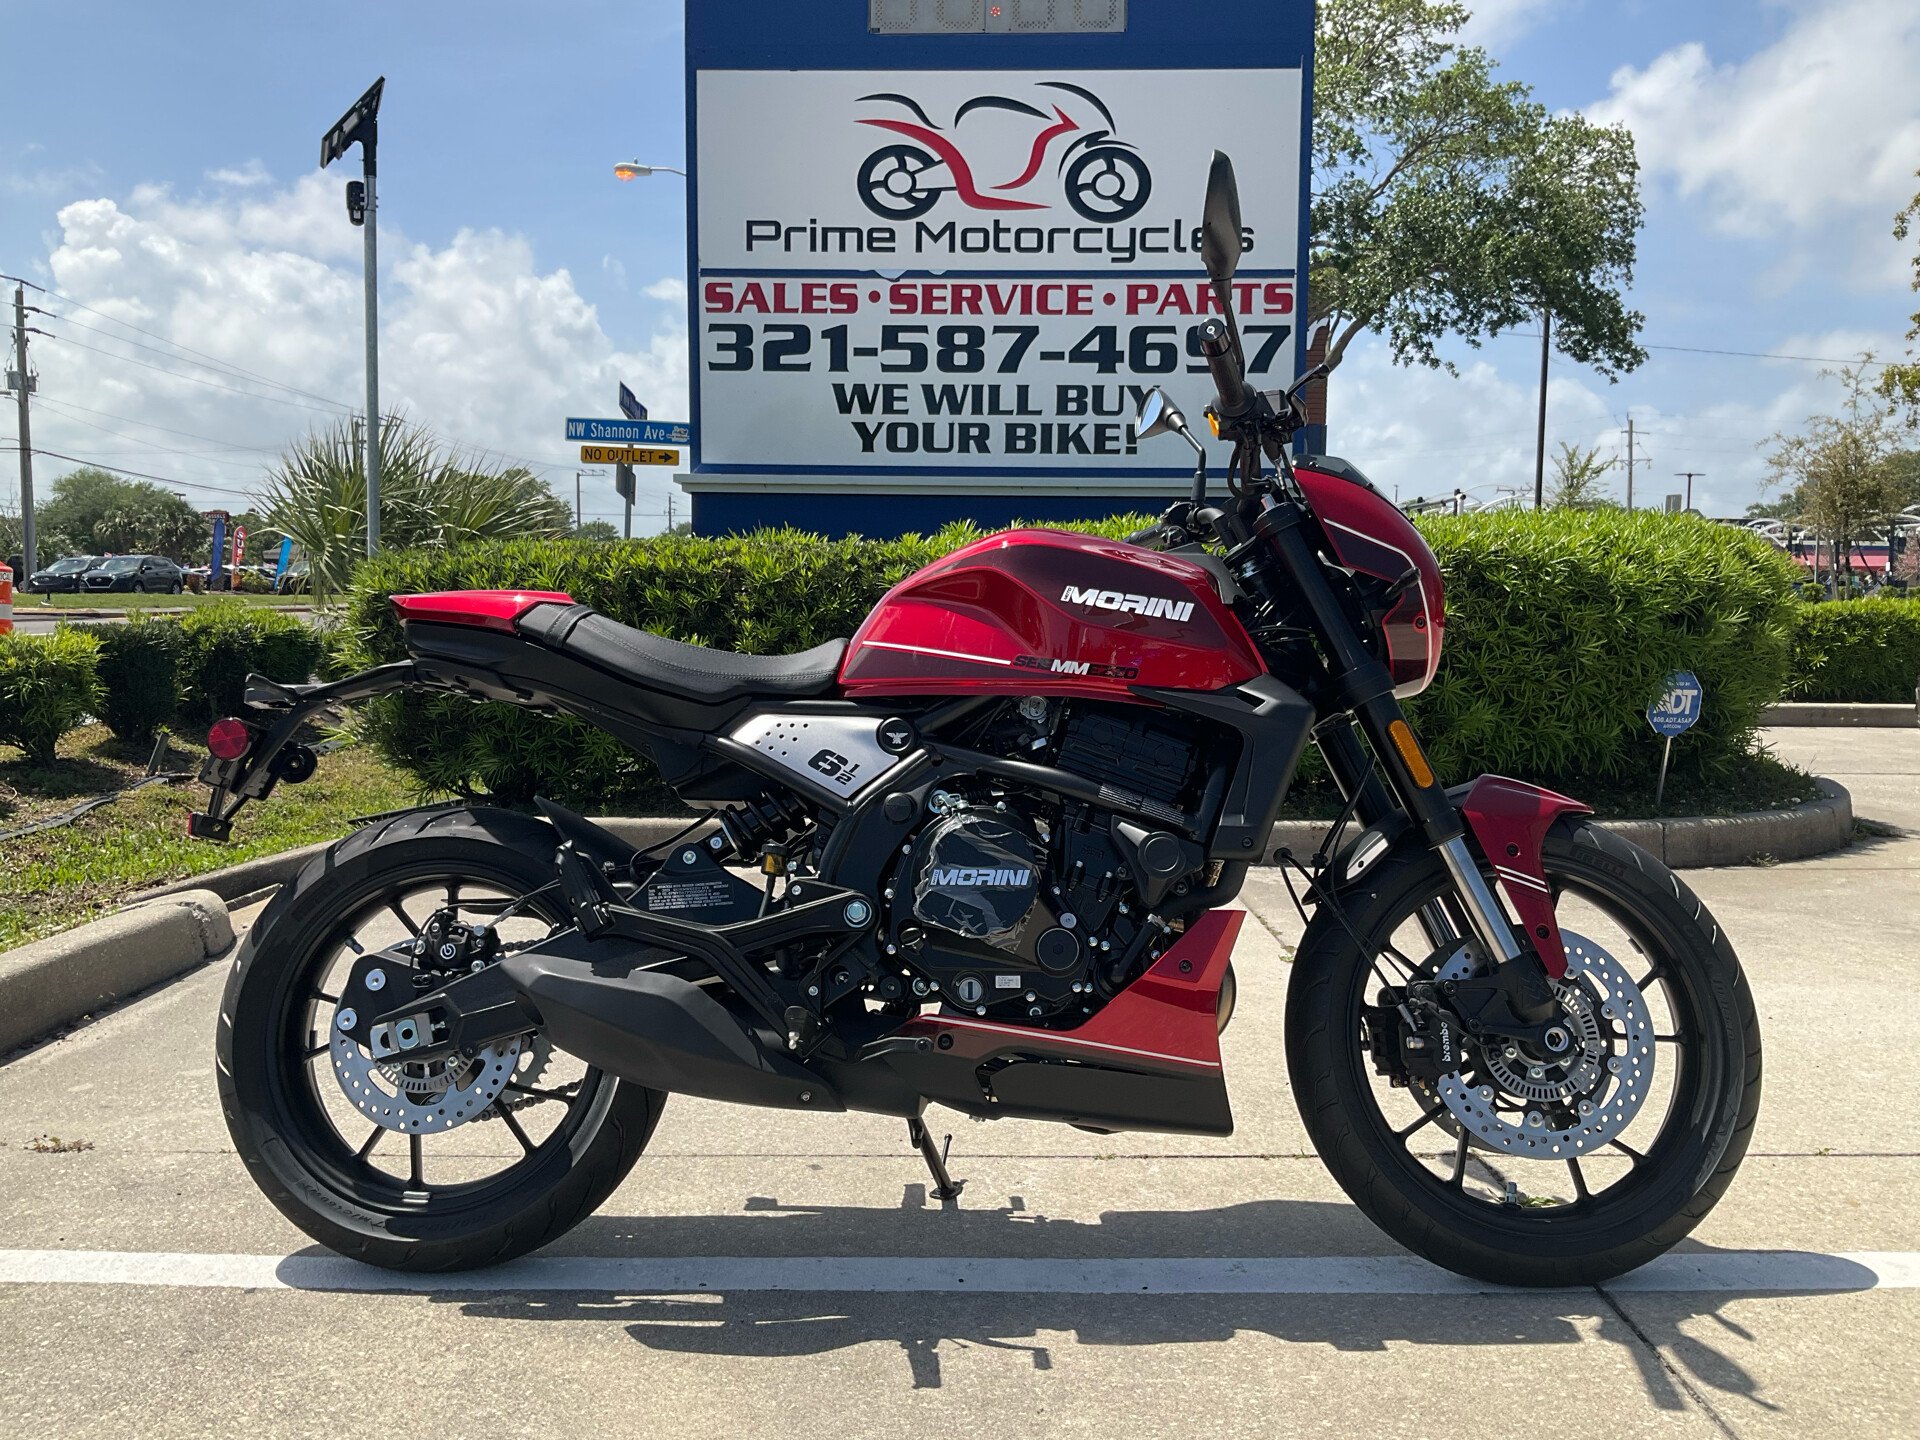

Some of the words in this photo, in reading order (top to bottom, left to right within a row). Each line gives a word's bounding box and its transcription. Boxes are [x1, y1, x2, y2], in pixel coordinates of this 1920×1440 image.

[745, 218, 896, 253] Prime
[704, 282, 859, 314] SALES
[889, 283, 1094, 315] SERVICE
[1125, 283, 1294, 316] PARTS
[831, 383, 910, 415] WE
[920, 384, 1043, 416] WILL
[568, 422, 586, 437] NW
[590, 423, 639, 440] Shannon
[644, 425, 665, 441] Ave
[850, 421, 992, 455] YOUR
[1004, 423, 1139, 456] BIKE!
[584, 448, 602, 461] NO
[607, 449, 655, 463] OUTLET
[1071, 586, 1195, 622] MORINI
[938, 869, 1031, 886] MORINI
[1440, 1020, 1451, 1063] brembo
